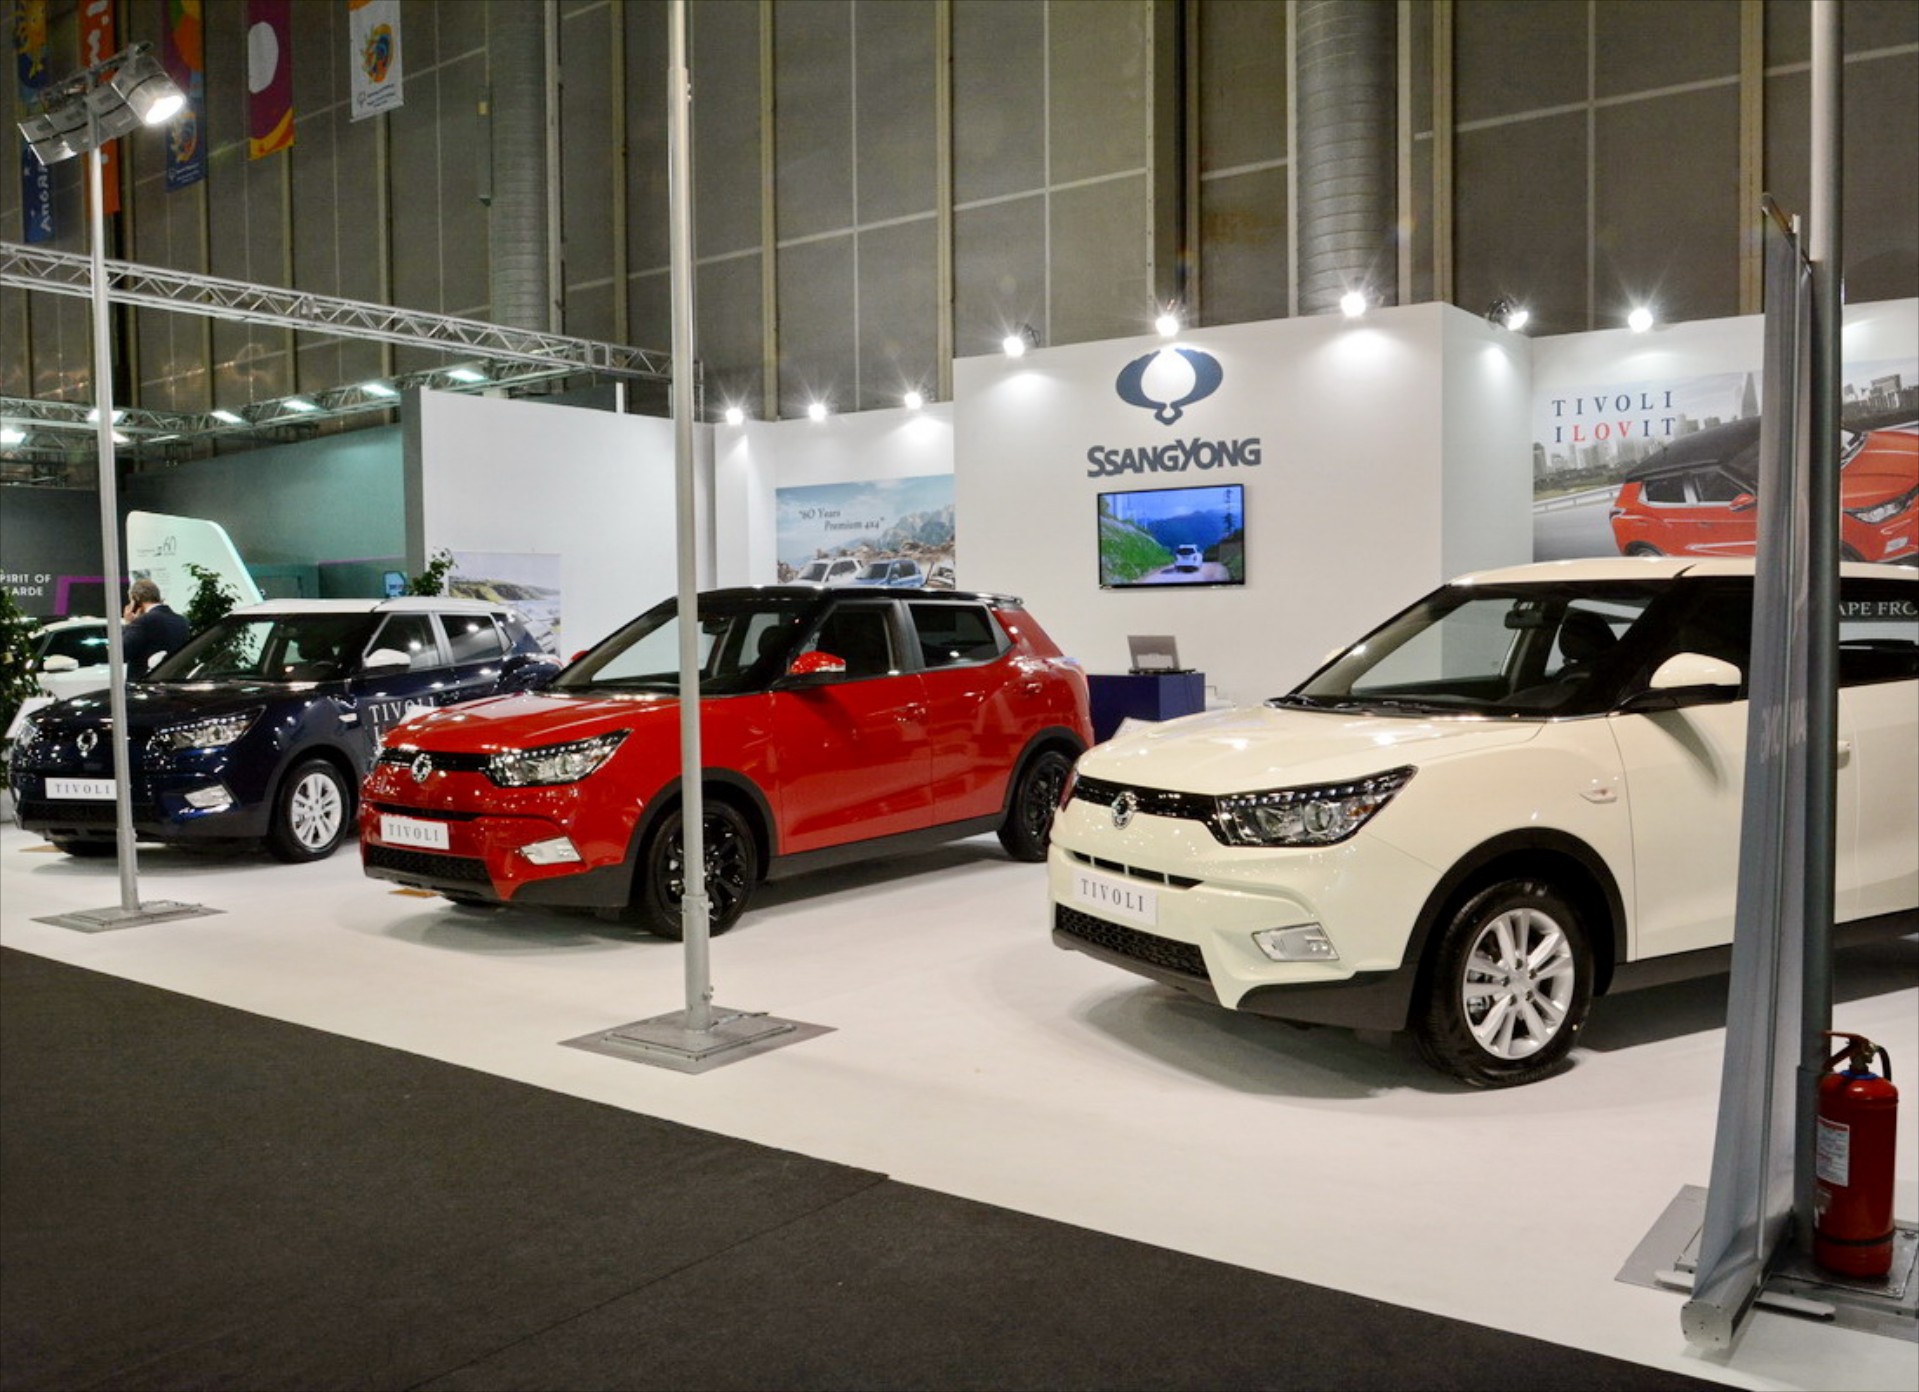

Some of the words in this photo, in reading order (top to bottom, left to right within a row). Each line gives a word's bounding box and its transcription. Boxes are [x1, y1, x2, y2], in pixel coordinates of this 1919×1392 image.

[1551, 390, 1672, 417] TIVOLI
[34, 573, 51, 584] OF
[55, 783, 110, 795] TIVOLI
[388, 823, 440, 843] TIVOLI
[1081, 878, 1144, 912] TIVOLI
